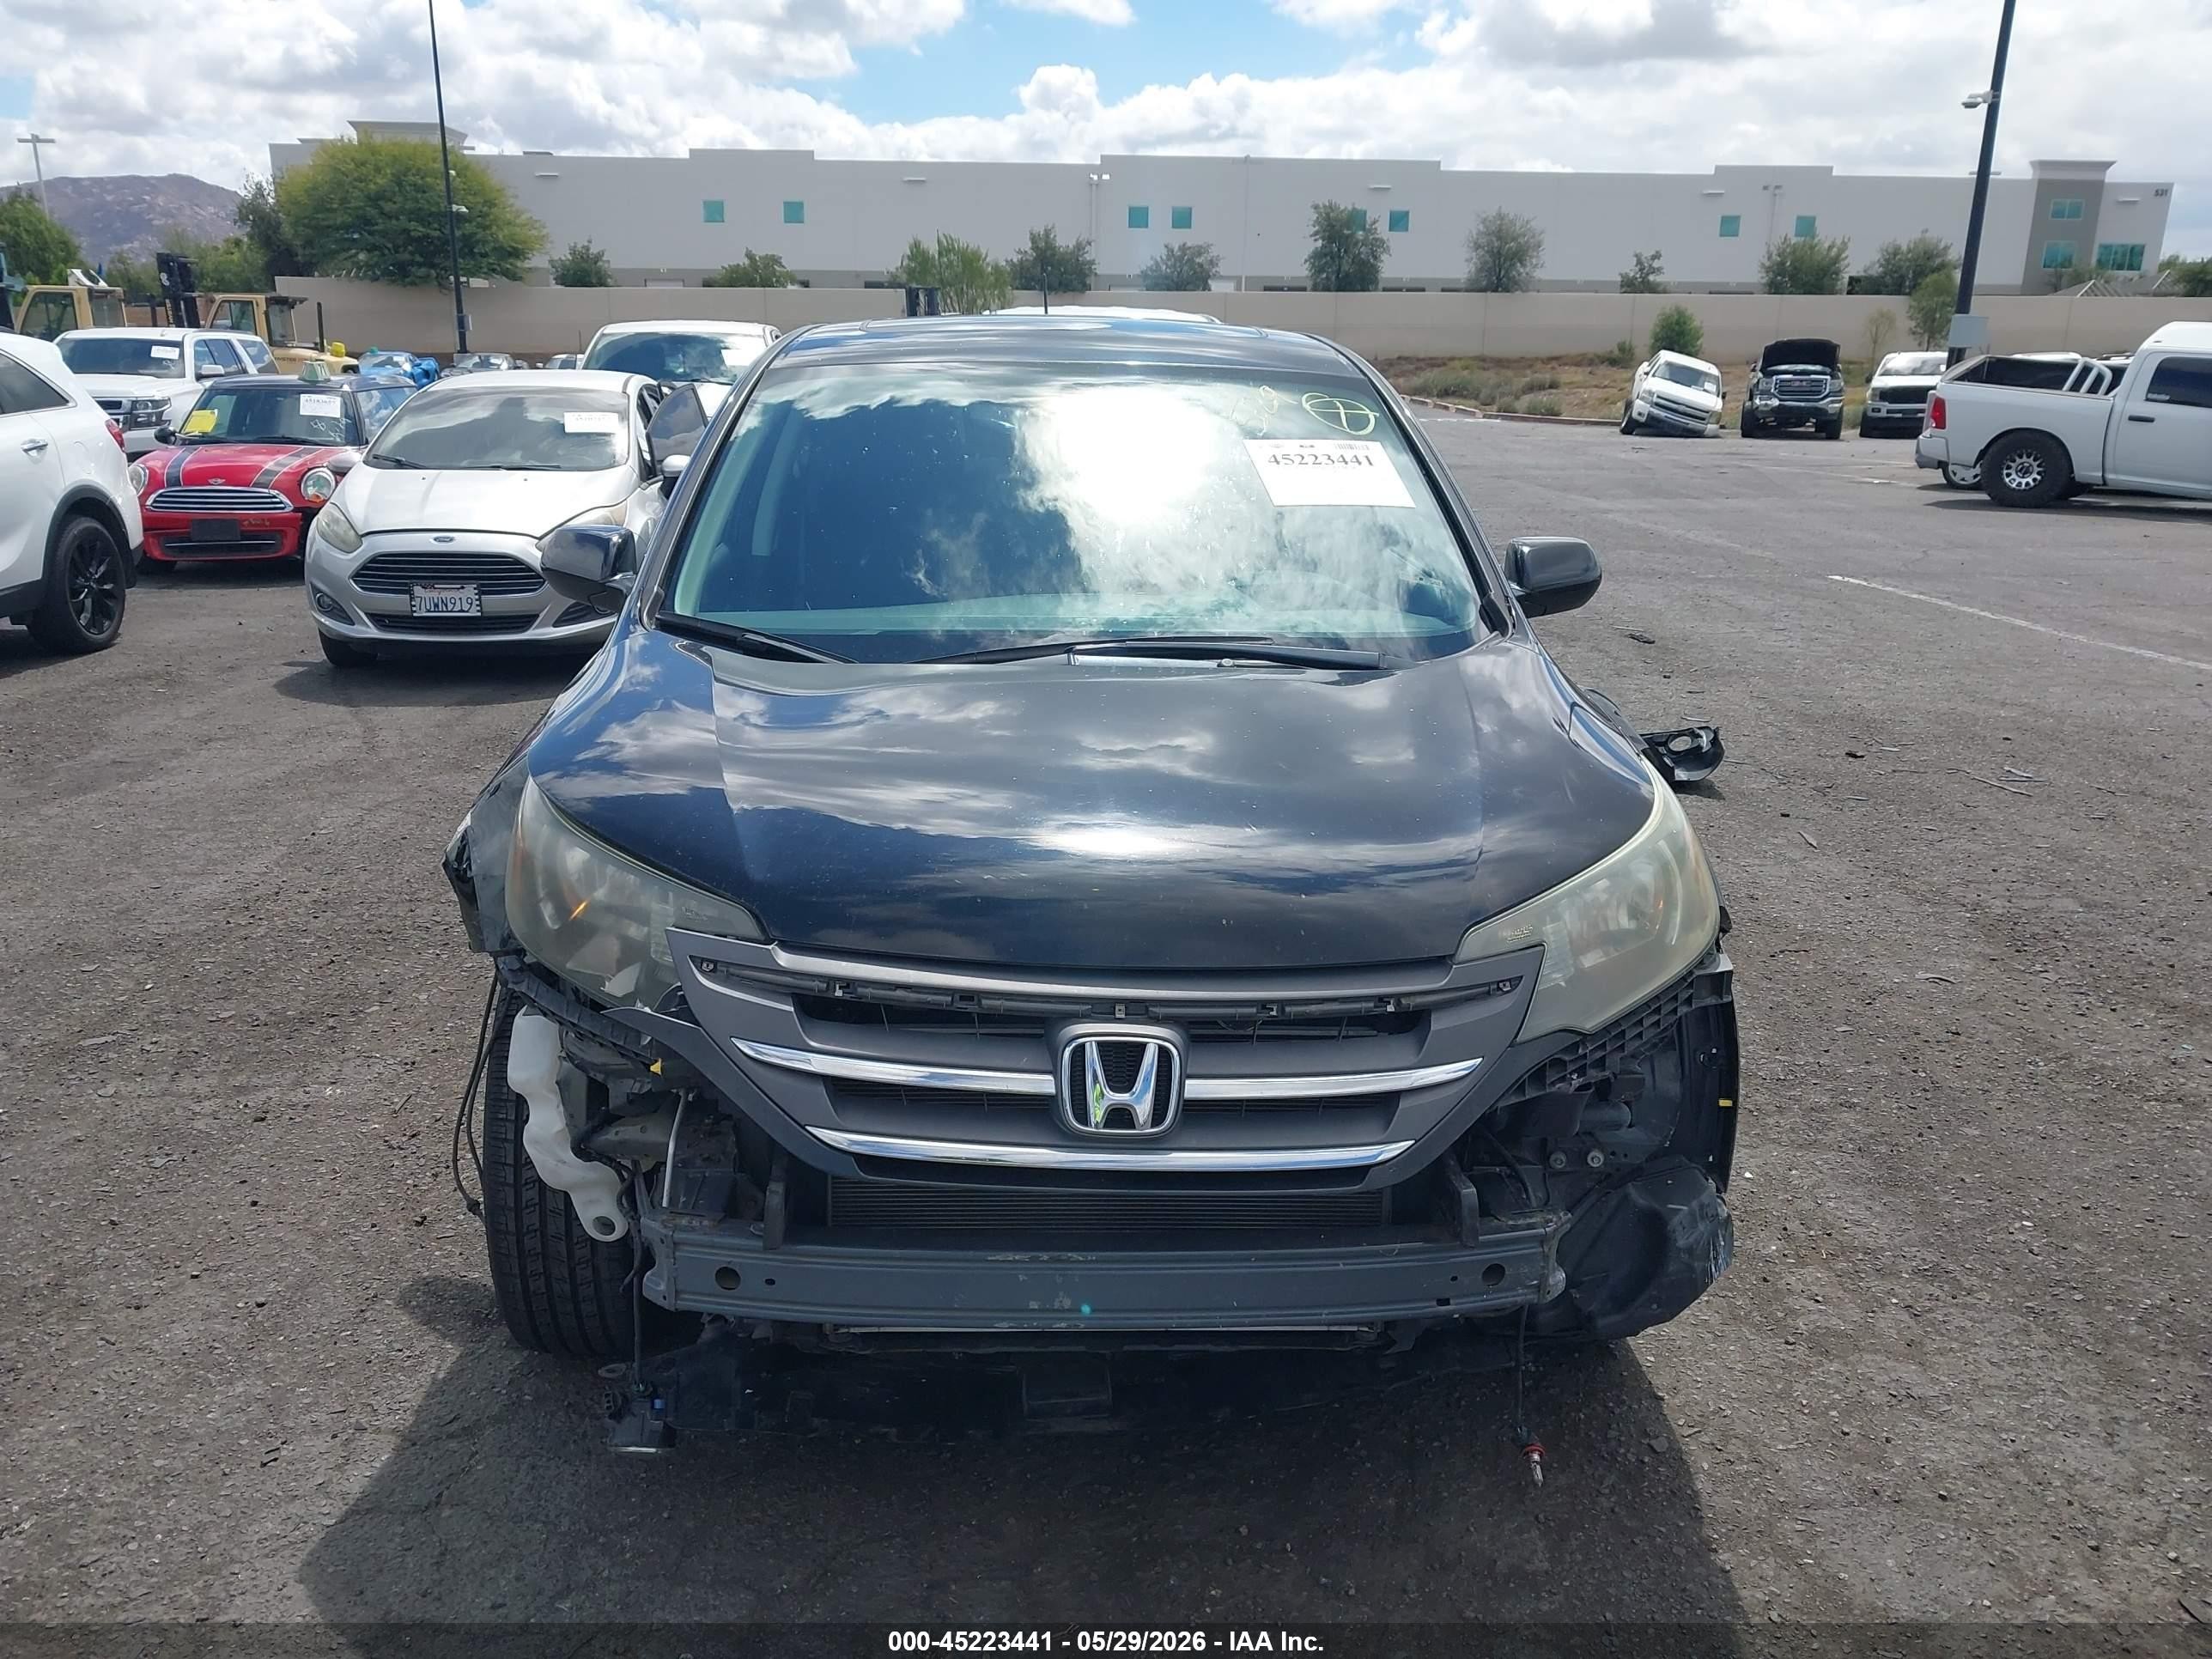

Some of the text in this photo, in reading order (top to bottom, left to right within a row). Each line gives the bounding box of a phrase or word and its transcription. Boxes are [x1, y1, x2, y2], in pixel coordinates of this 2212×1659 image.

[2154, 188, 2168, 198] 531
[1267, 453, 1374, 466] 45223441
[415, 596, 474, 612] 7UWN919
